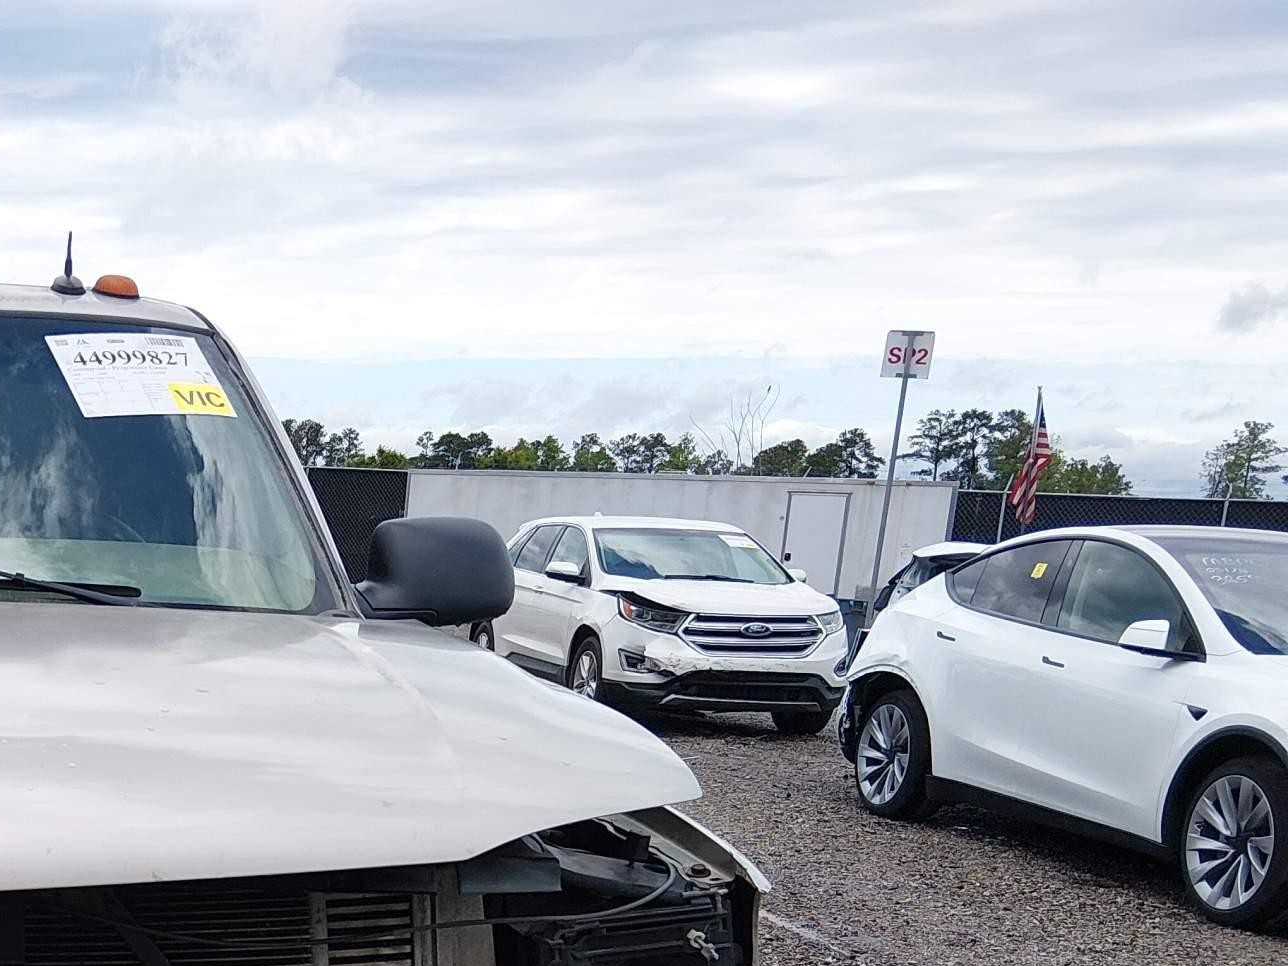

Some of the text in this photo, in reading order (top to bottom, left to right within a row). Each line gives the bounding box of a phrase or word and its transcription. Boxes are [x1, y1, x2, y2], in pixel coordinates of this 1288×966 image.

[73, 349, 188, 367] 44999827
[887, 346, 929, 365] SP2
[174, 389, 225, 408] VIC
